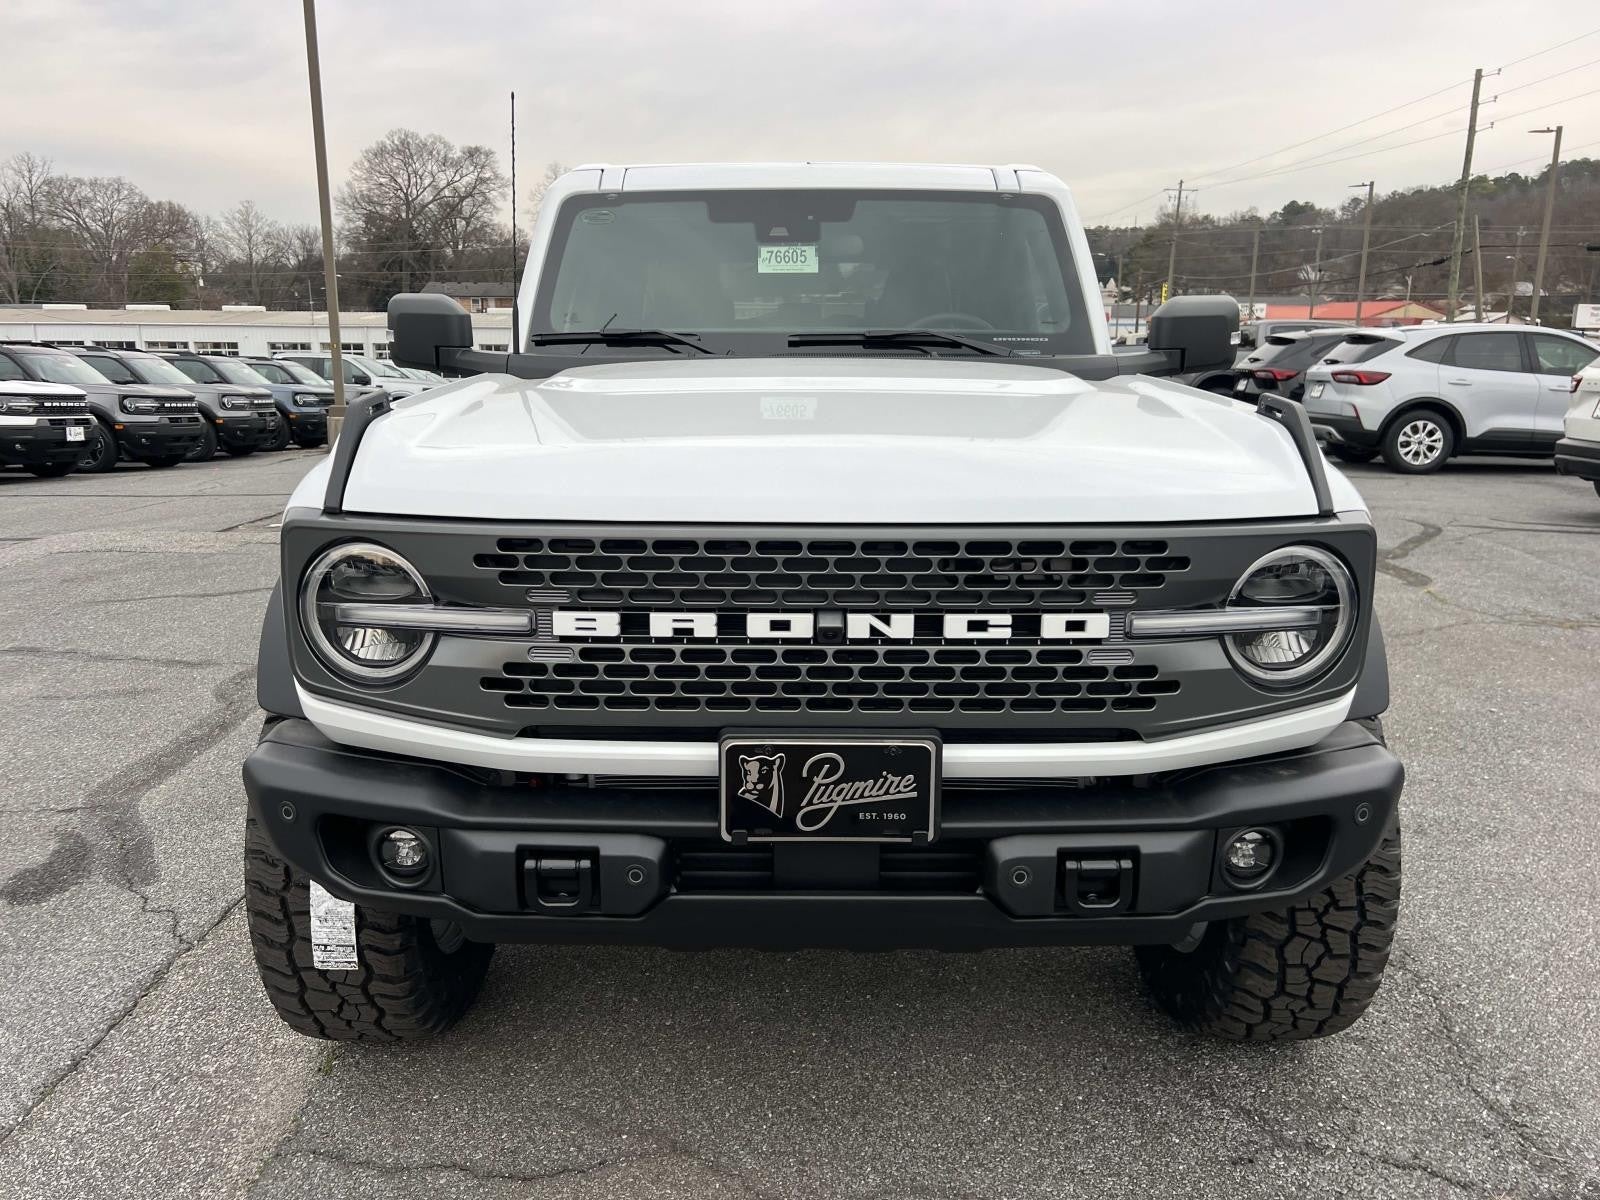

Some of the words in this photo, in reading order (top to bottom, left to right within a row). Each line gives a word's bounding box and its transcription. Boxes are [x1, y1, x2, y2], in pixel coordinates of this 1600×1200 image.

[766, 250, 807, 264] 76605
[552, 610, 1110, 639] BRONCO
[796, 752, 918, 832] Pugmire
[859, 812, 880, 820] EST.
[883, 812, 907, 820] 1960
